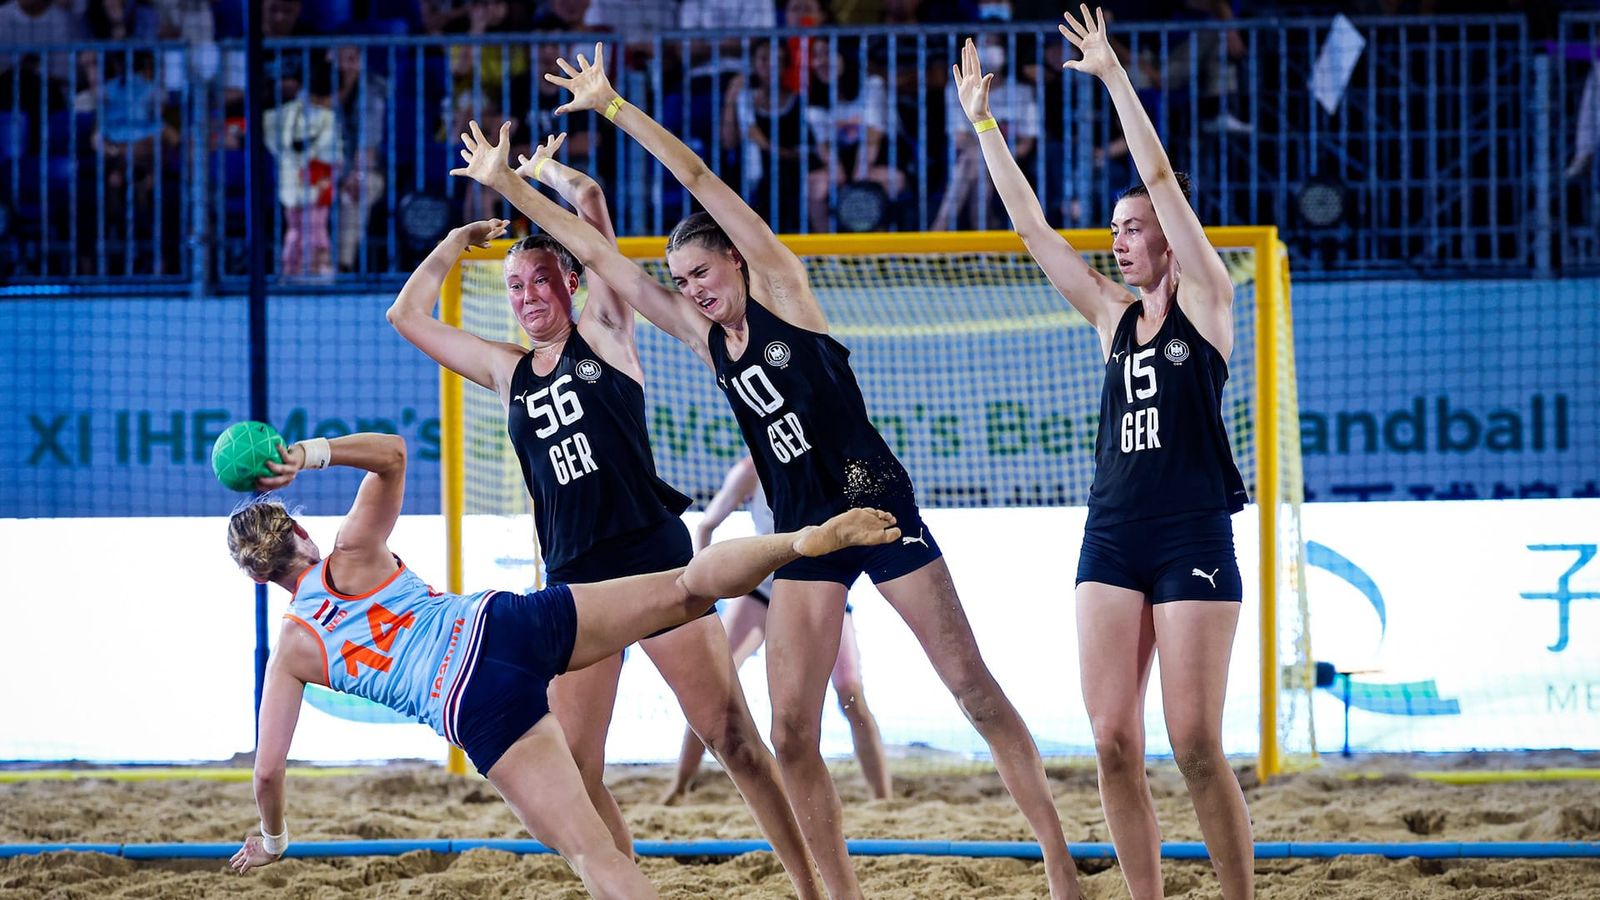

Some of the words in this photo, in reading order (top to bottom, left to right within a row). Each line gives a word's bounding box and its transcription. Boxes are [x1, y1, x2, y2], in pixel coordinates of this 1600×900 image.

[731, 364, 784, 418] 10
[1124, 348, 1157, 403] 15
[526, 374, 584, 439] 56
[1121, 407, 1161, 453] GER
[29, 411, 92, 466] XI
[116, 409, 230, 465] IHF
[548, 432, 599, 485] GER
[766, 412, 812, 464] GER
[326, 609, 348, 633] NED
[340, 602, 416, 678] 14
